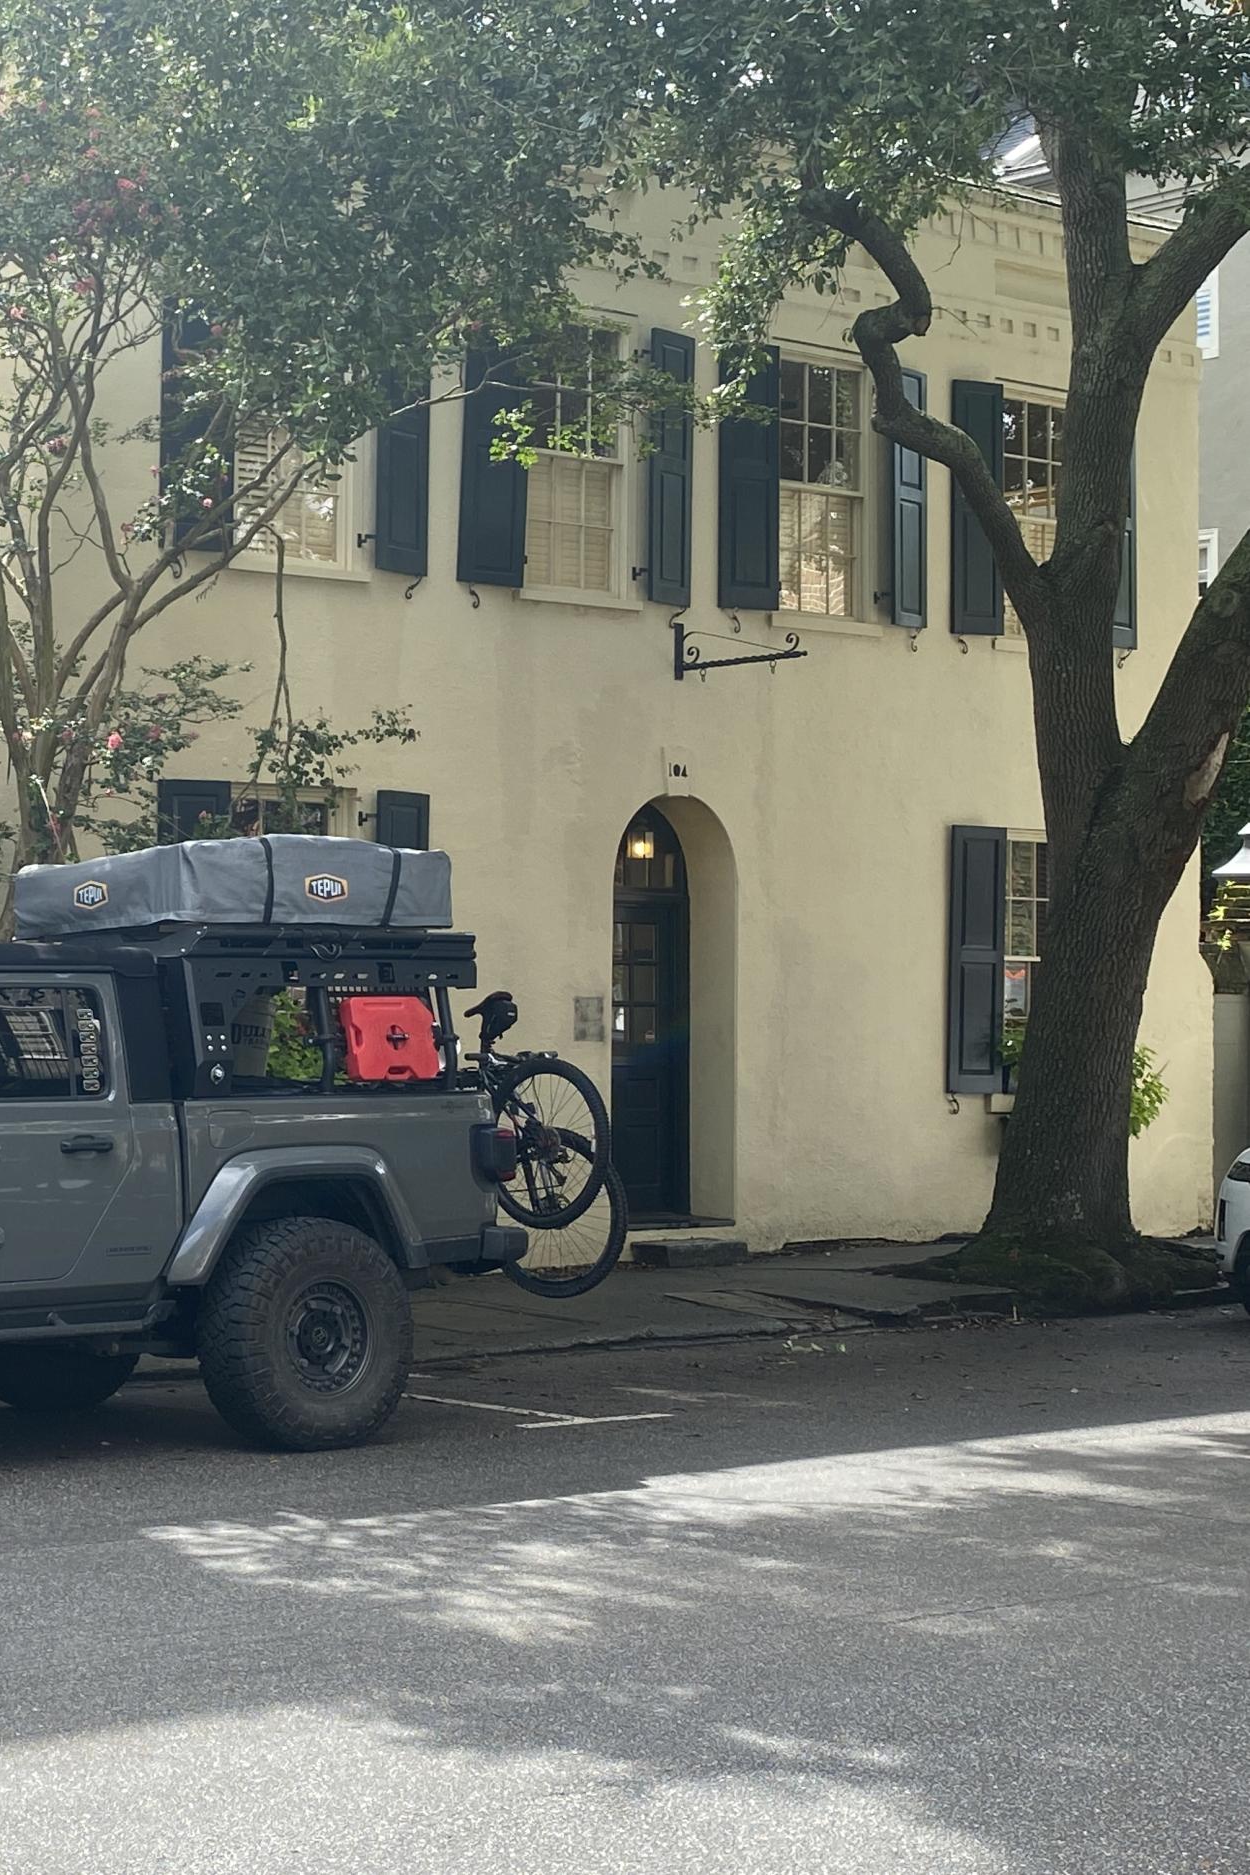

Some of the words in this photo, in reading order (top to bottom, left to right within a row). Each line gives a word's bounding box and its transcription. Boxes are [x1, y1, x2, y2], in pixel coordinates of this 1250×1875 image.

[668, 762, 688, 778] 104
[78, 885, 103, 905] TEPUI
[310, 878, 342, 898] TEPUI
